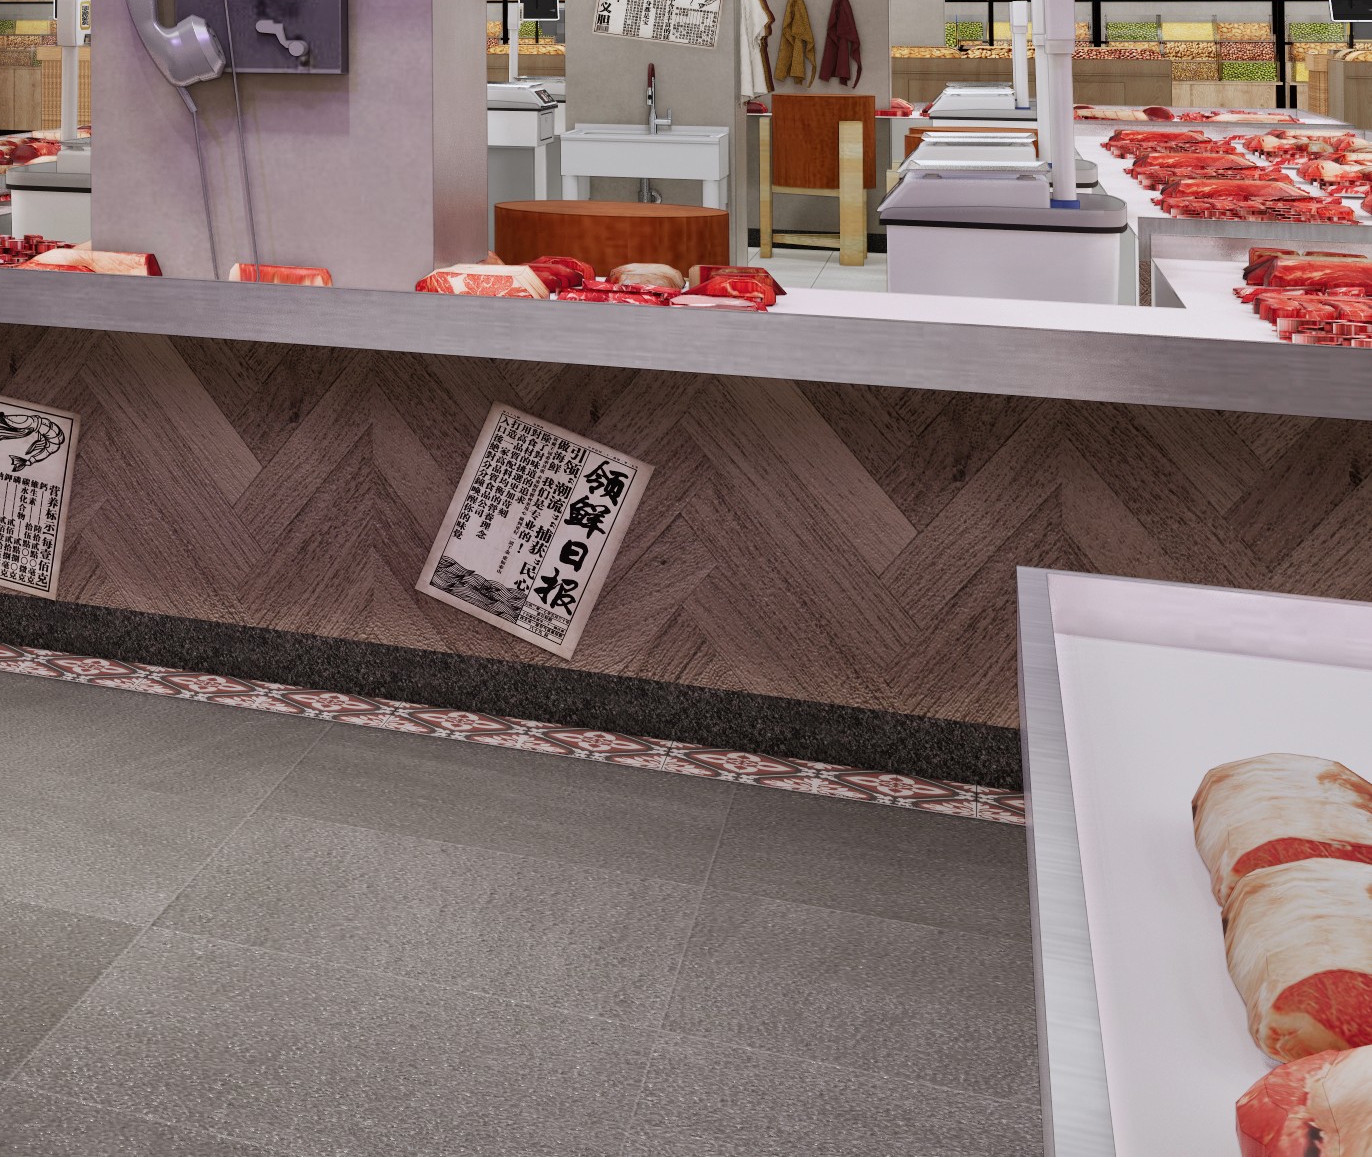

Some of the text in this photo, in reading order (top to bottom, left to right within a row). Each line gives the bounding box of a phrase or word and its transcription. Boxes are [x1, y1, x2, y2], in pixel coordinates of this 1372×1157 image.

[514, 431, 552, 505] 除了對味道的追求
[516, 440, 571, 554] 做海鲜 我们是专业的！
[533, 460, 629, 616] 领鲜日报
